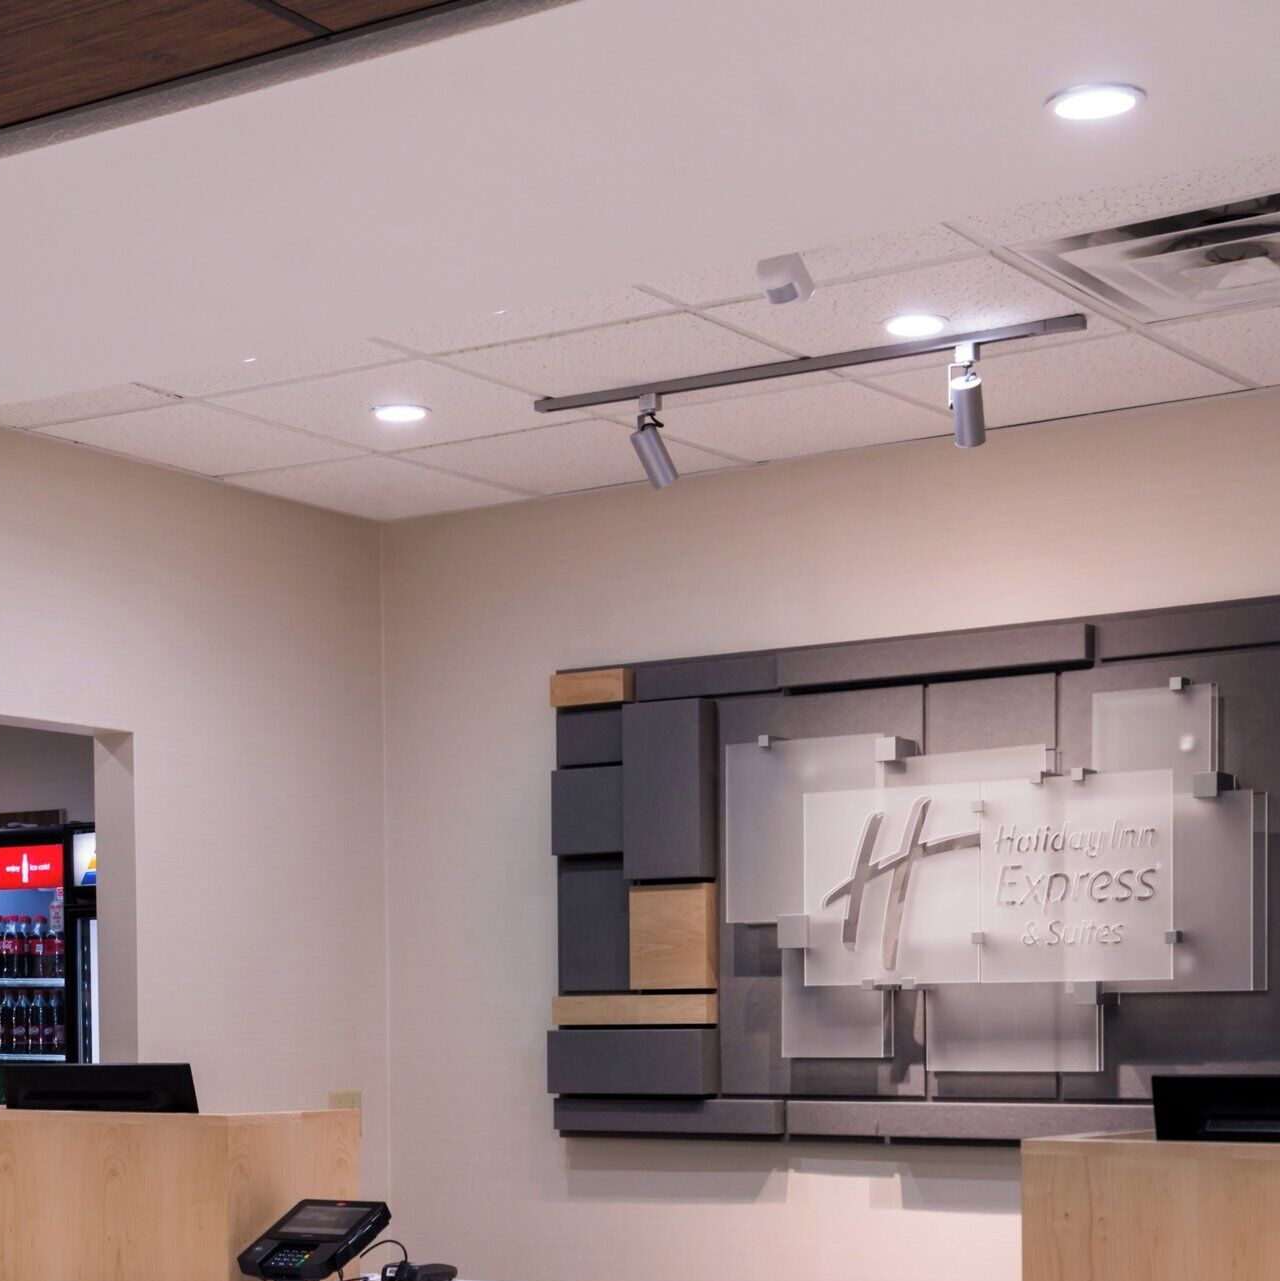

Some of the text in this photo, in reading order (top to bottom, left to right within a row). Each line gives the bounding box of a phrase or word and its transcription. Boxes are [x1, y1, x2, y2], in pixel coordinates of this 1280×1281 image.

[993, 817, 1157, 858] Holiday Inn
[995, 864, 1158, 916] Express
[1022, 919, 1124, 946] & Suites
